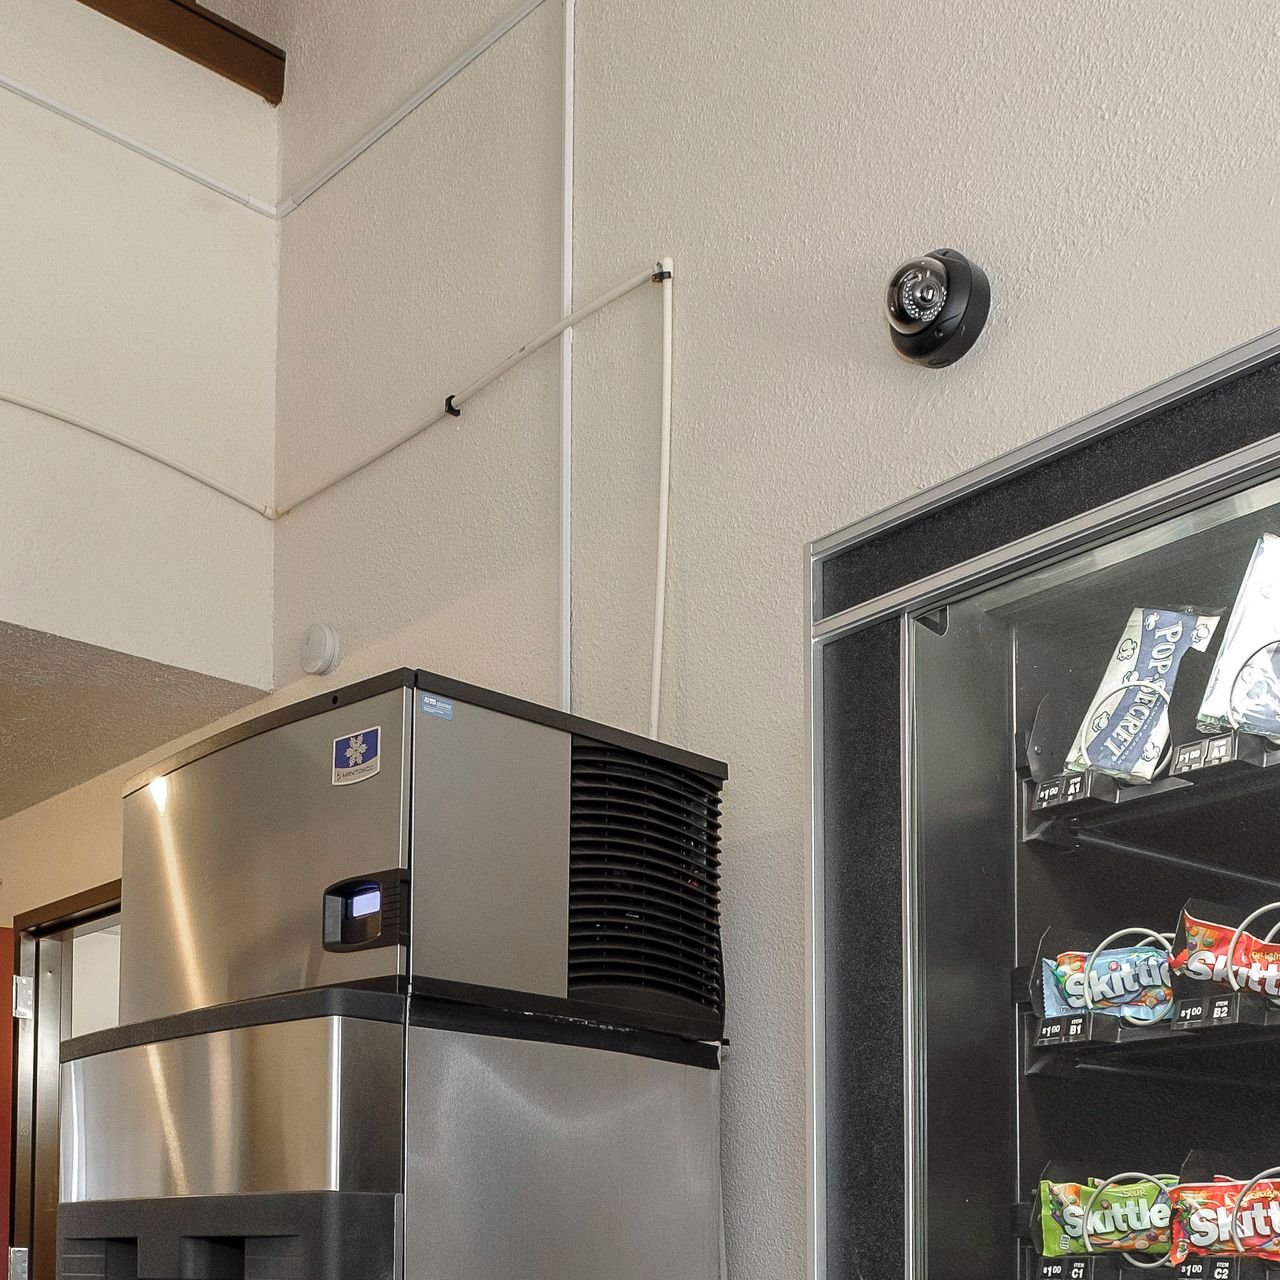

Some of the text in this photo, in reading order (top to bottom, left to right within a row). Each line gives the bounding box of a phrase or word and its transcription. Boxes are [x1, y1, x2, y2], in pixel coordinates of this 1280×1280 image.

[1148, 621, 1183, 675] POP
[1068, 783, 1081, 794] A1
[1213, 1007, 1228, 1018] B2
[1070, 1025, 1081, 1035] B1
[1062, 1198, 1170, 1237] Skittle
[1072, 1267, 1083, 1279] C1
[1214, 1268, 1228, 1280] C2
